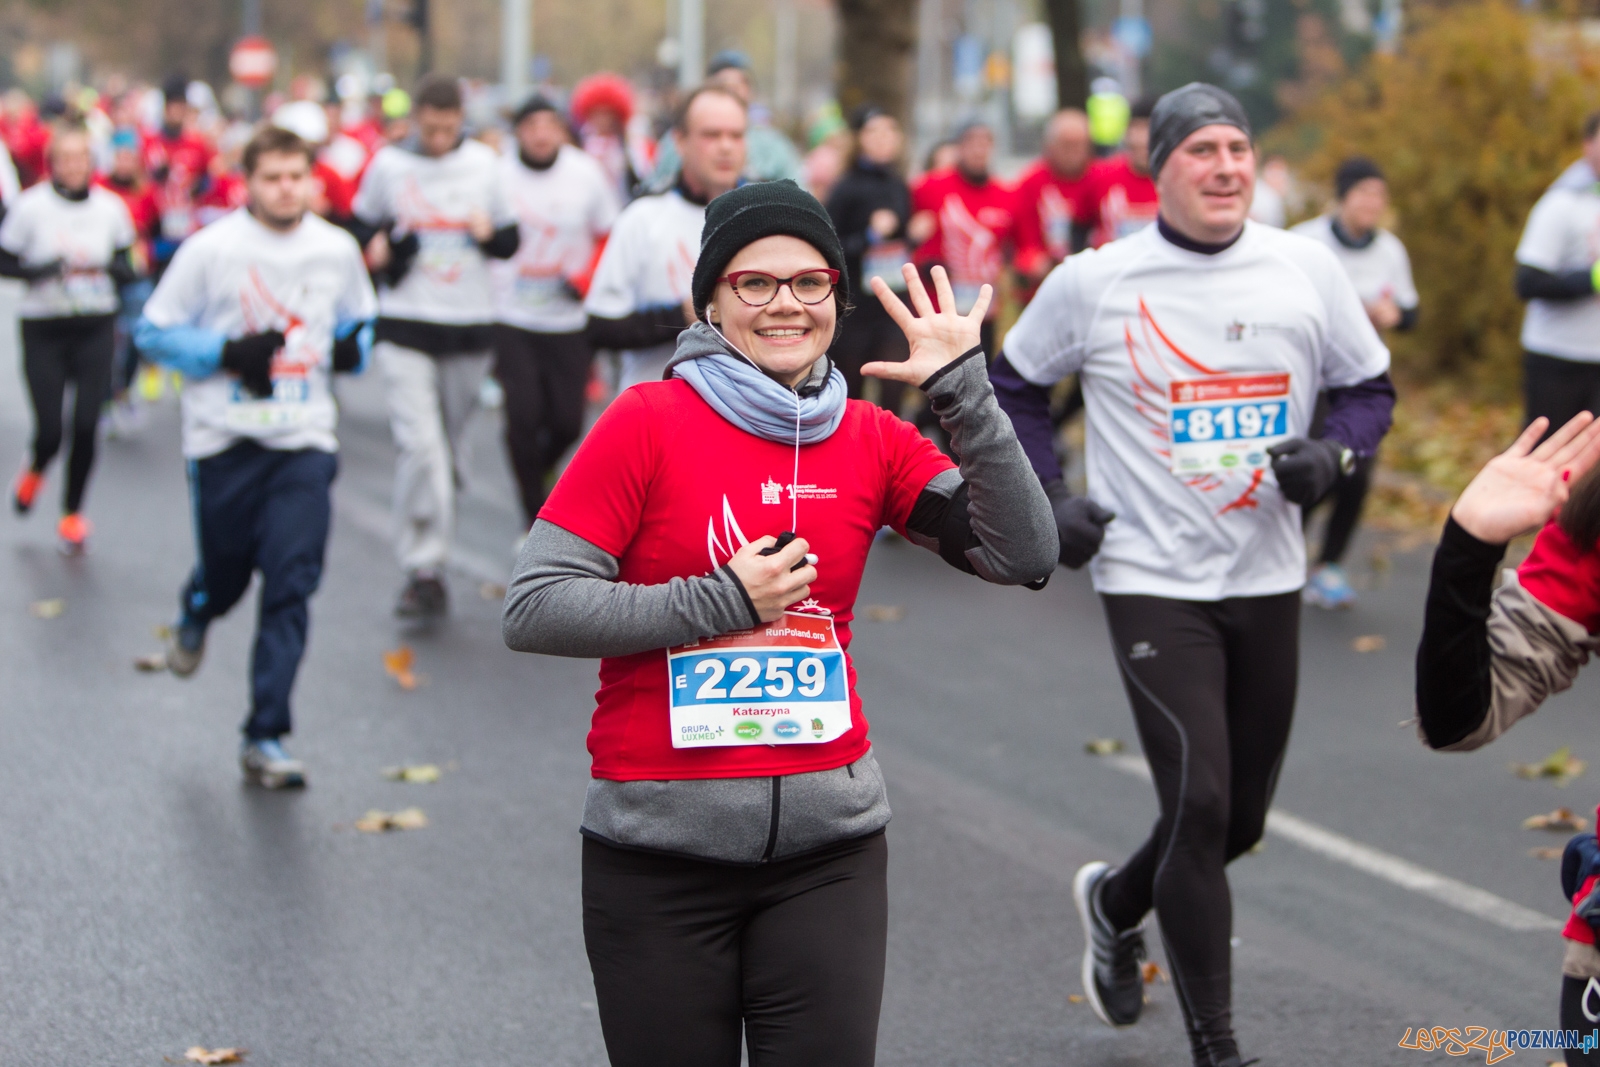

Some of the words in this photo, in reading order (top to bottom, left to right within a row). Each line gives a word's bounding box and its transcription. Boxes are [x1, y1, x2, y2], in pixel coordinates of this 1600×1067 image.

[1187, 403, 1281, 441] 8197
[765, 628, 826, 642] RunPoland.org
[675, 674, 688, 689] E
[694, 656, 826, 700] 2259
[732, 707, 791, 718] Katarzyna
[681, 725, 710, 733] GRUPA
[681, 732, 716, 741] LUXMED
